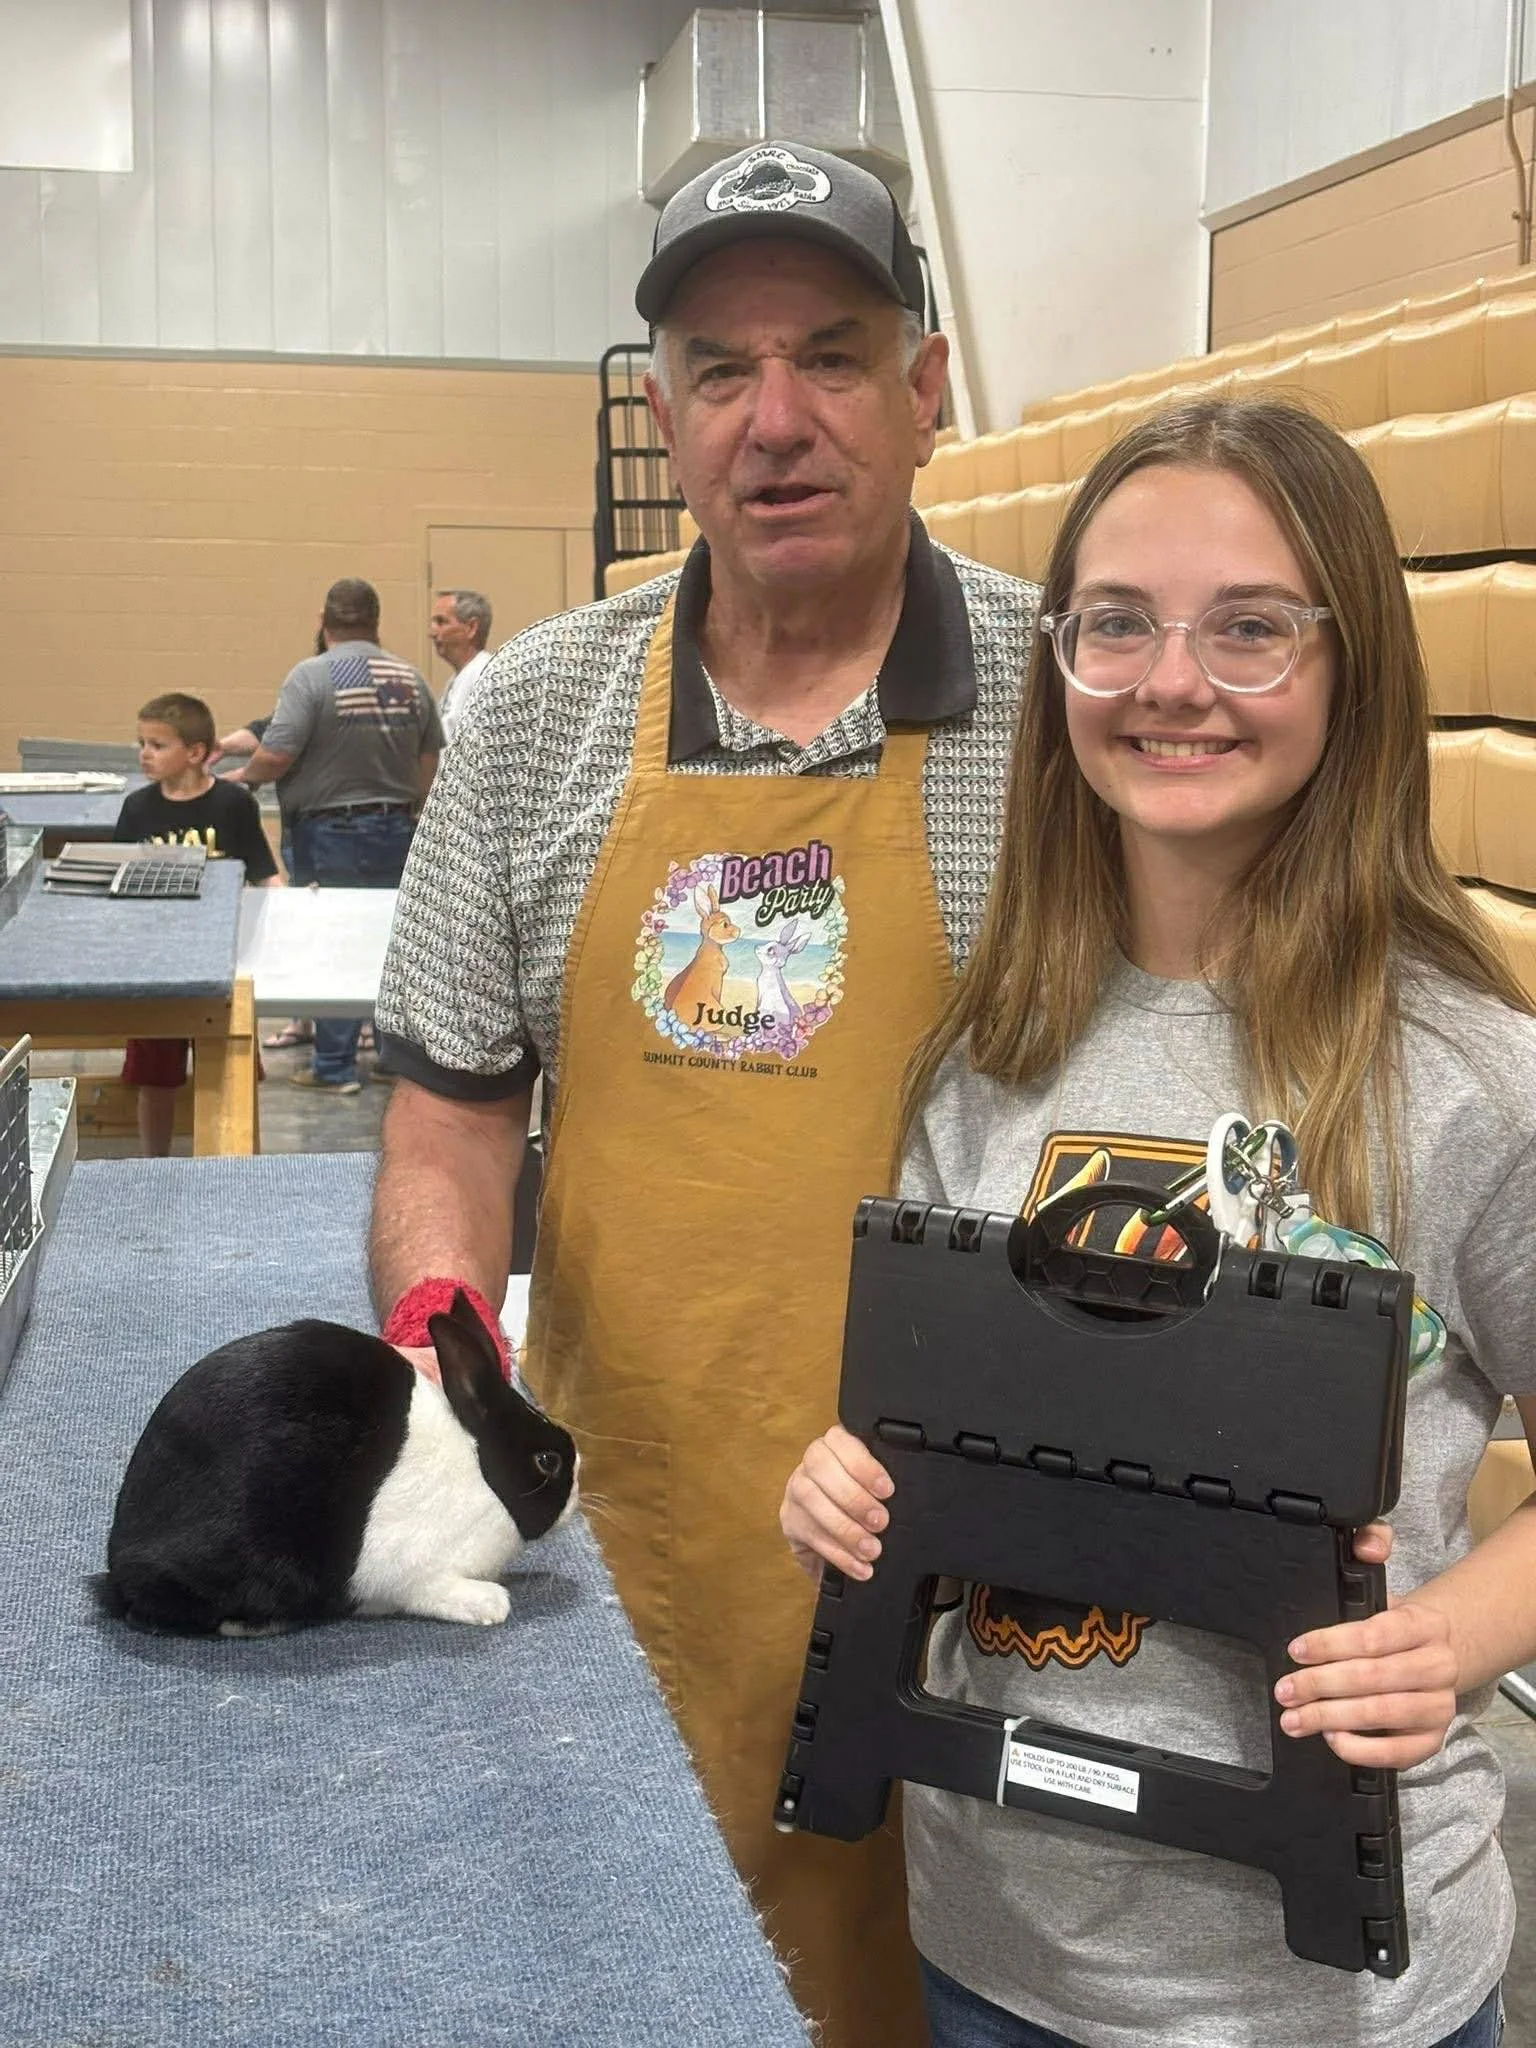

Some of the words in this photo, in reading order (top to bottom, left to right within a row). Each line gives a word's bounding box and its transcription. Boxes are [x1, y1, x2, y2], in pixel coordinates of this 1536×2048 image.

[719, 840, 833, 903] Beach
[755, 879, 834, 927] Party
[692, 1002, 776, 1034] Judge
[643, 1051, 684, 1066] SUMMIT
[688, 1056, 737, 1071] COUNTY
[740, 1060, 783, 1075] RABBIT
[786, 1065, 818, 1078] CLUB
[1010, 1758, 1021, 1766] USE
[1044, 1766, 1055, 1774] ON
[1061, 1771, 1076, 1781] FLAT
[1076, 1775, 1092, 1784] AND
[1092, 1777, 1106, 1787] DRY
[1024, 1752, 1045, 1763] HOLDS
[1056, 1760, 1065, 1768] TO
[1065, 1761, 1078, 1770] 200
[1078, 1765, 1087, 1773] LB
[1043, 1776, 1056, 1785] USE
[1057, 1780, 1074, 1789] WITH
